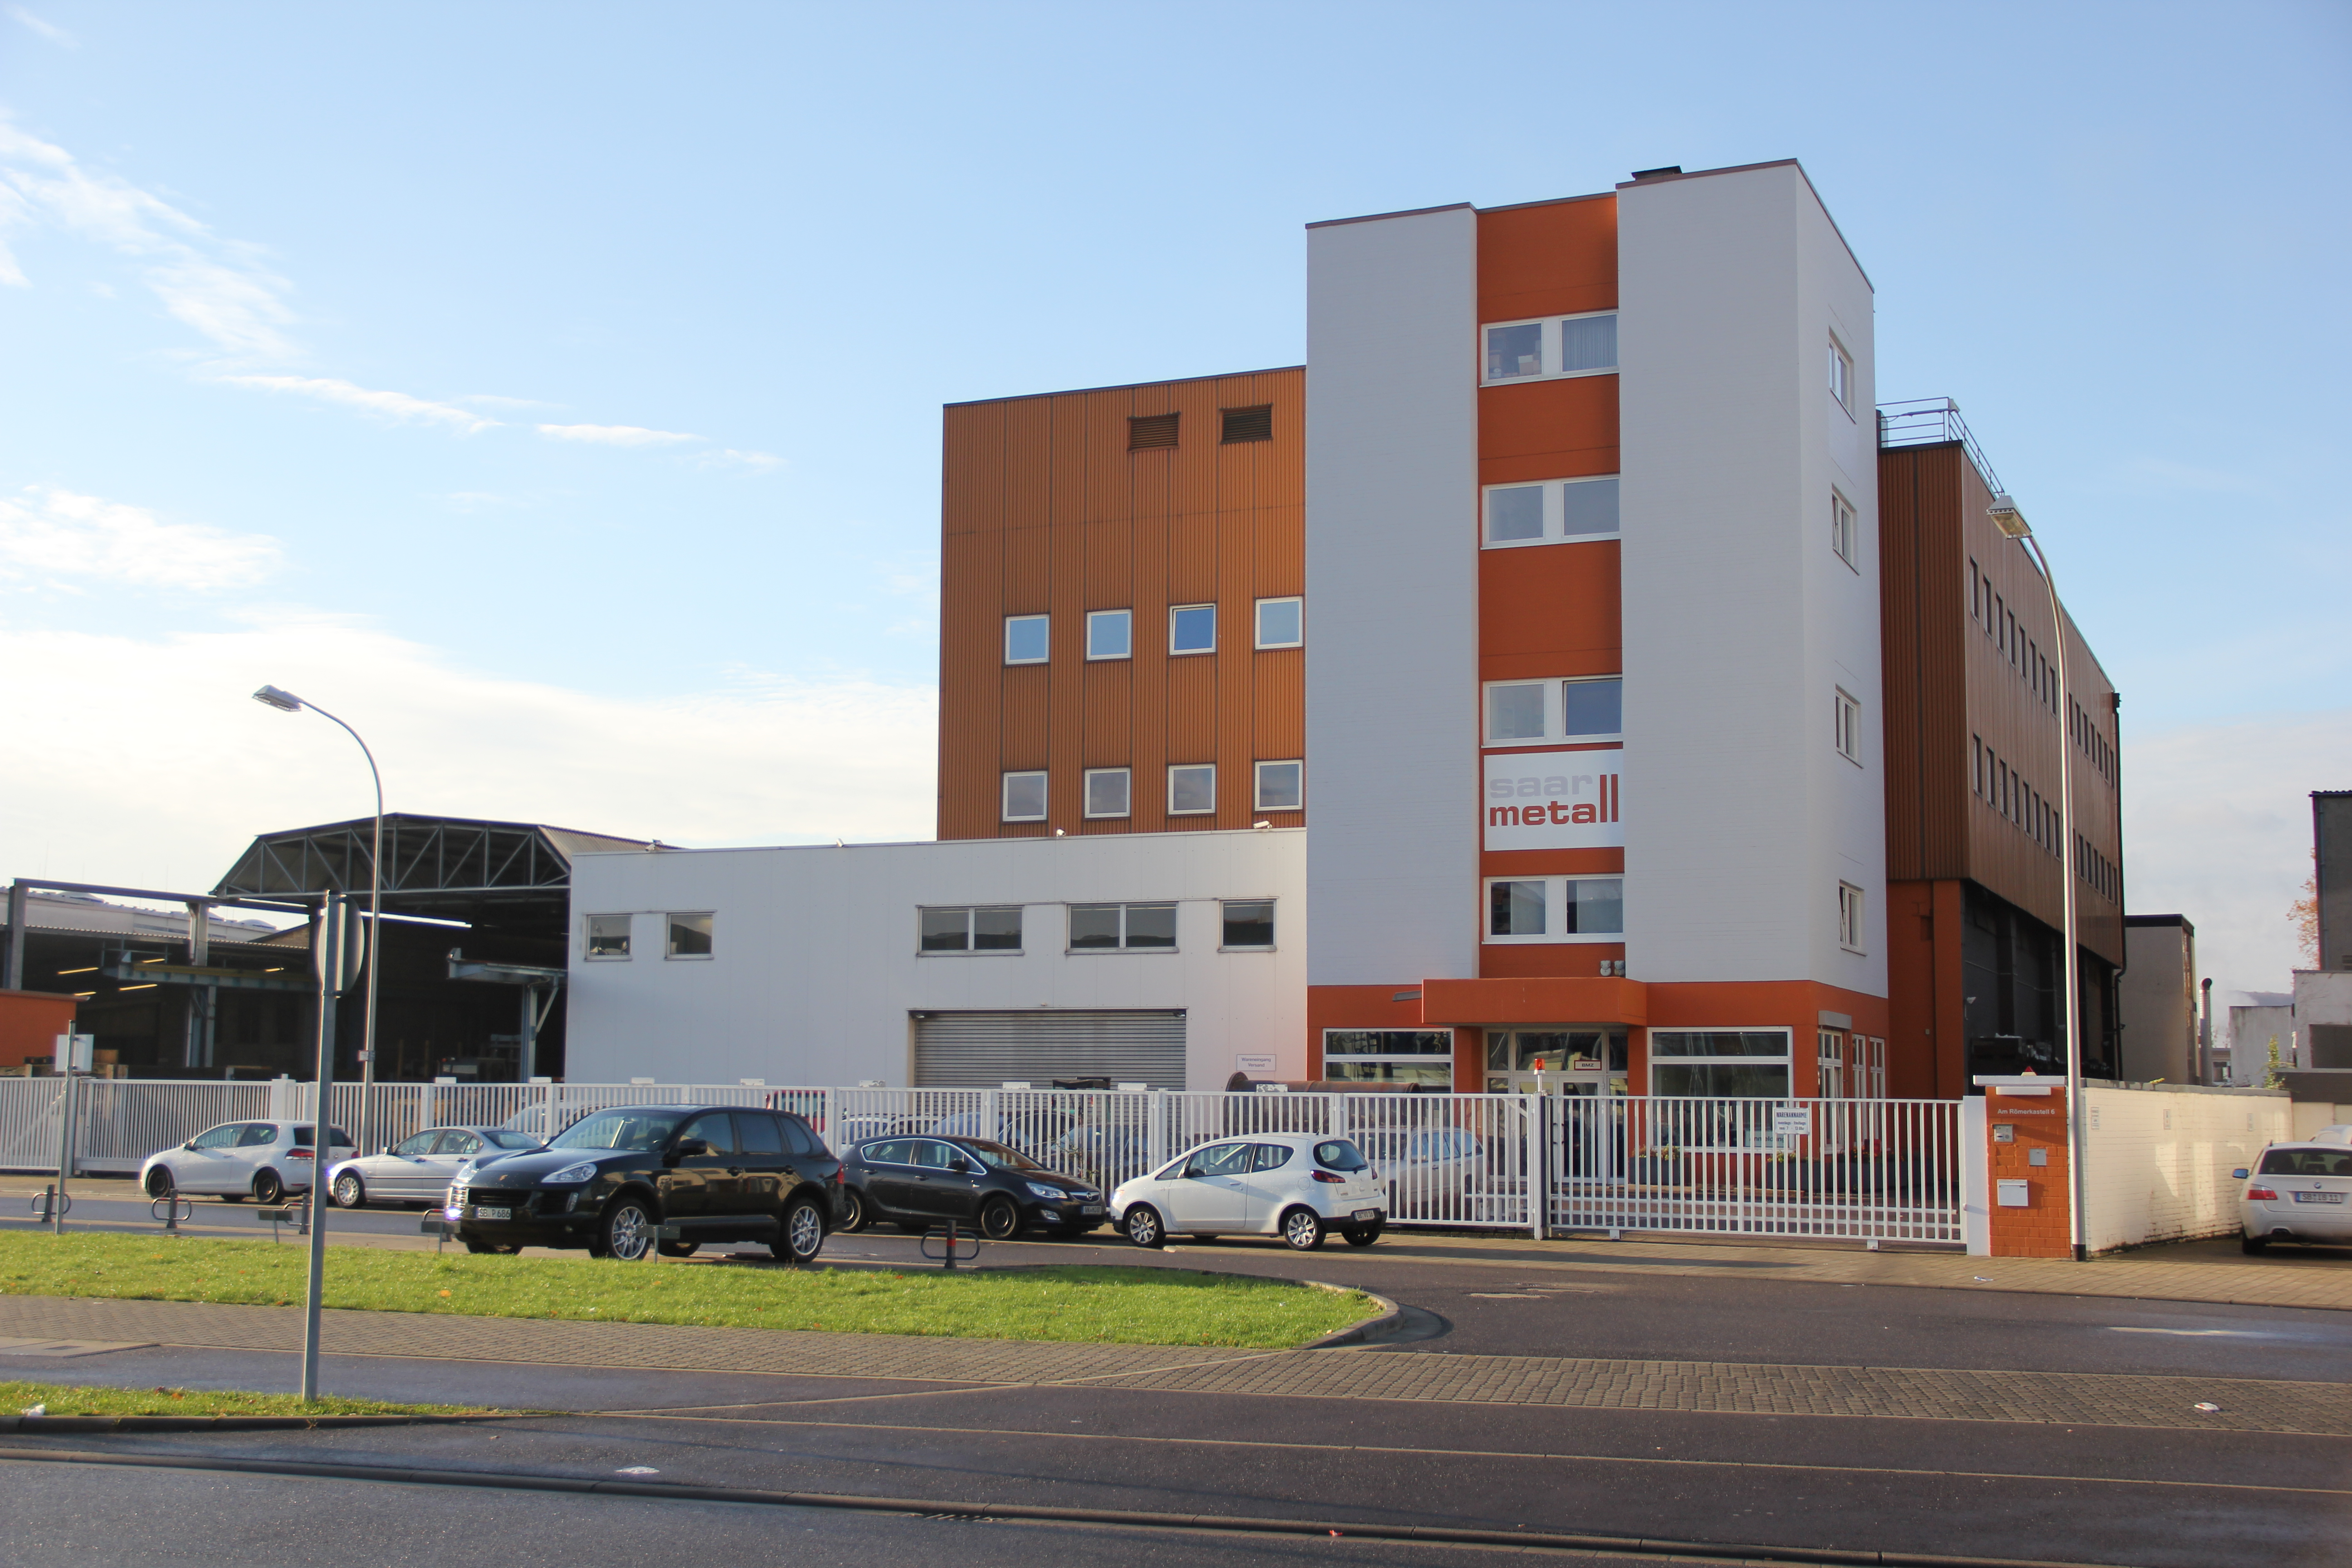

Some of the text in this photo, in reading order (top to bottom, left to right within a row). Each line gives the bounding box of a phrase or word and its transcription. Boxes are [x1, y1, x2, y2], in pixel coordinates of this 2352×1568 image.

[1490, 775, 1593, 799] saar
[1490, 774, 1619, 827] metall
[480, 1208, 510, 1218] SB P 686
